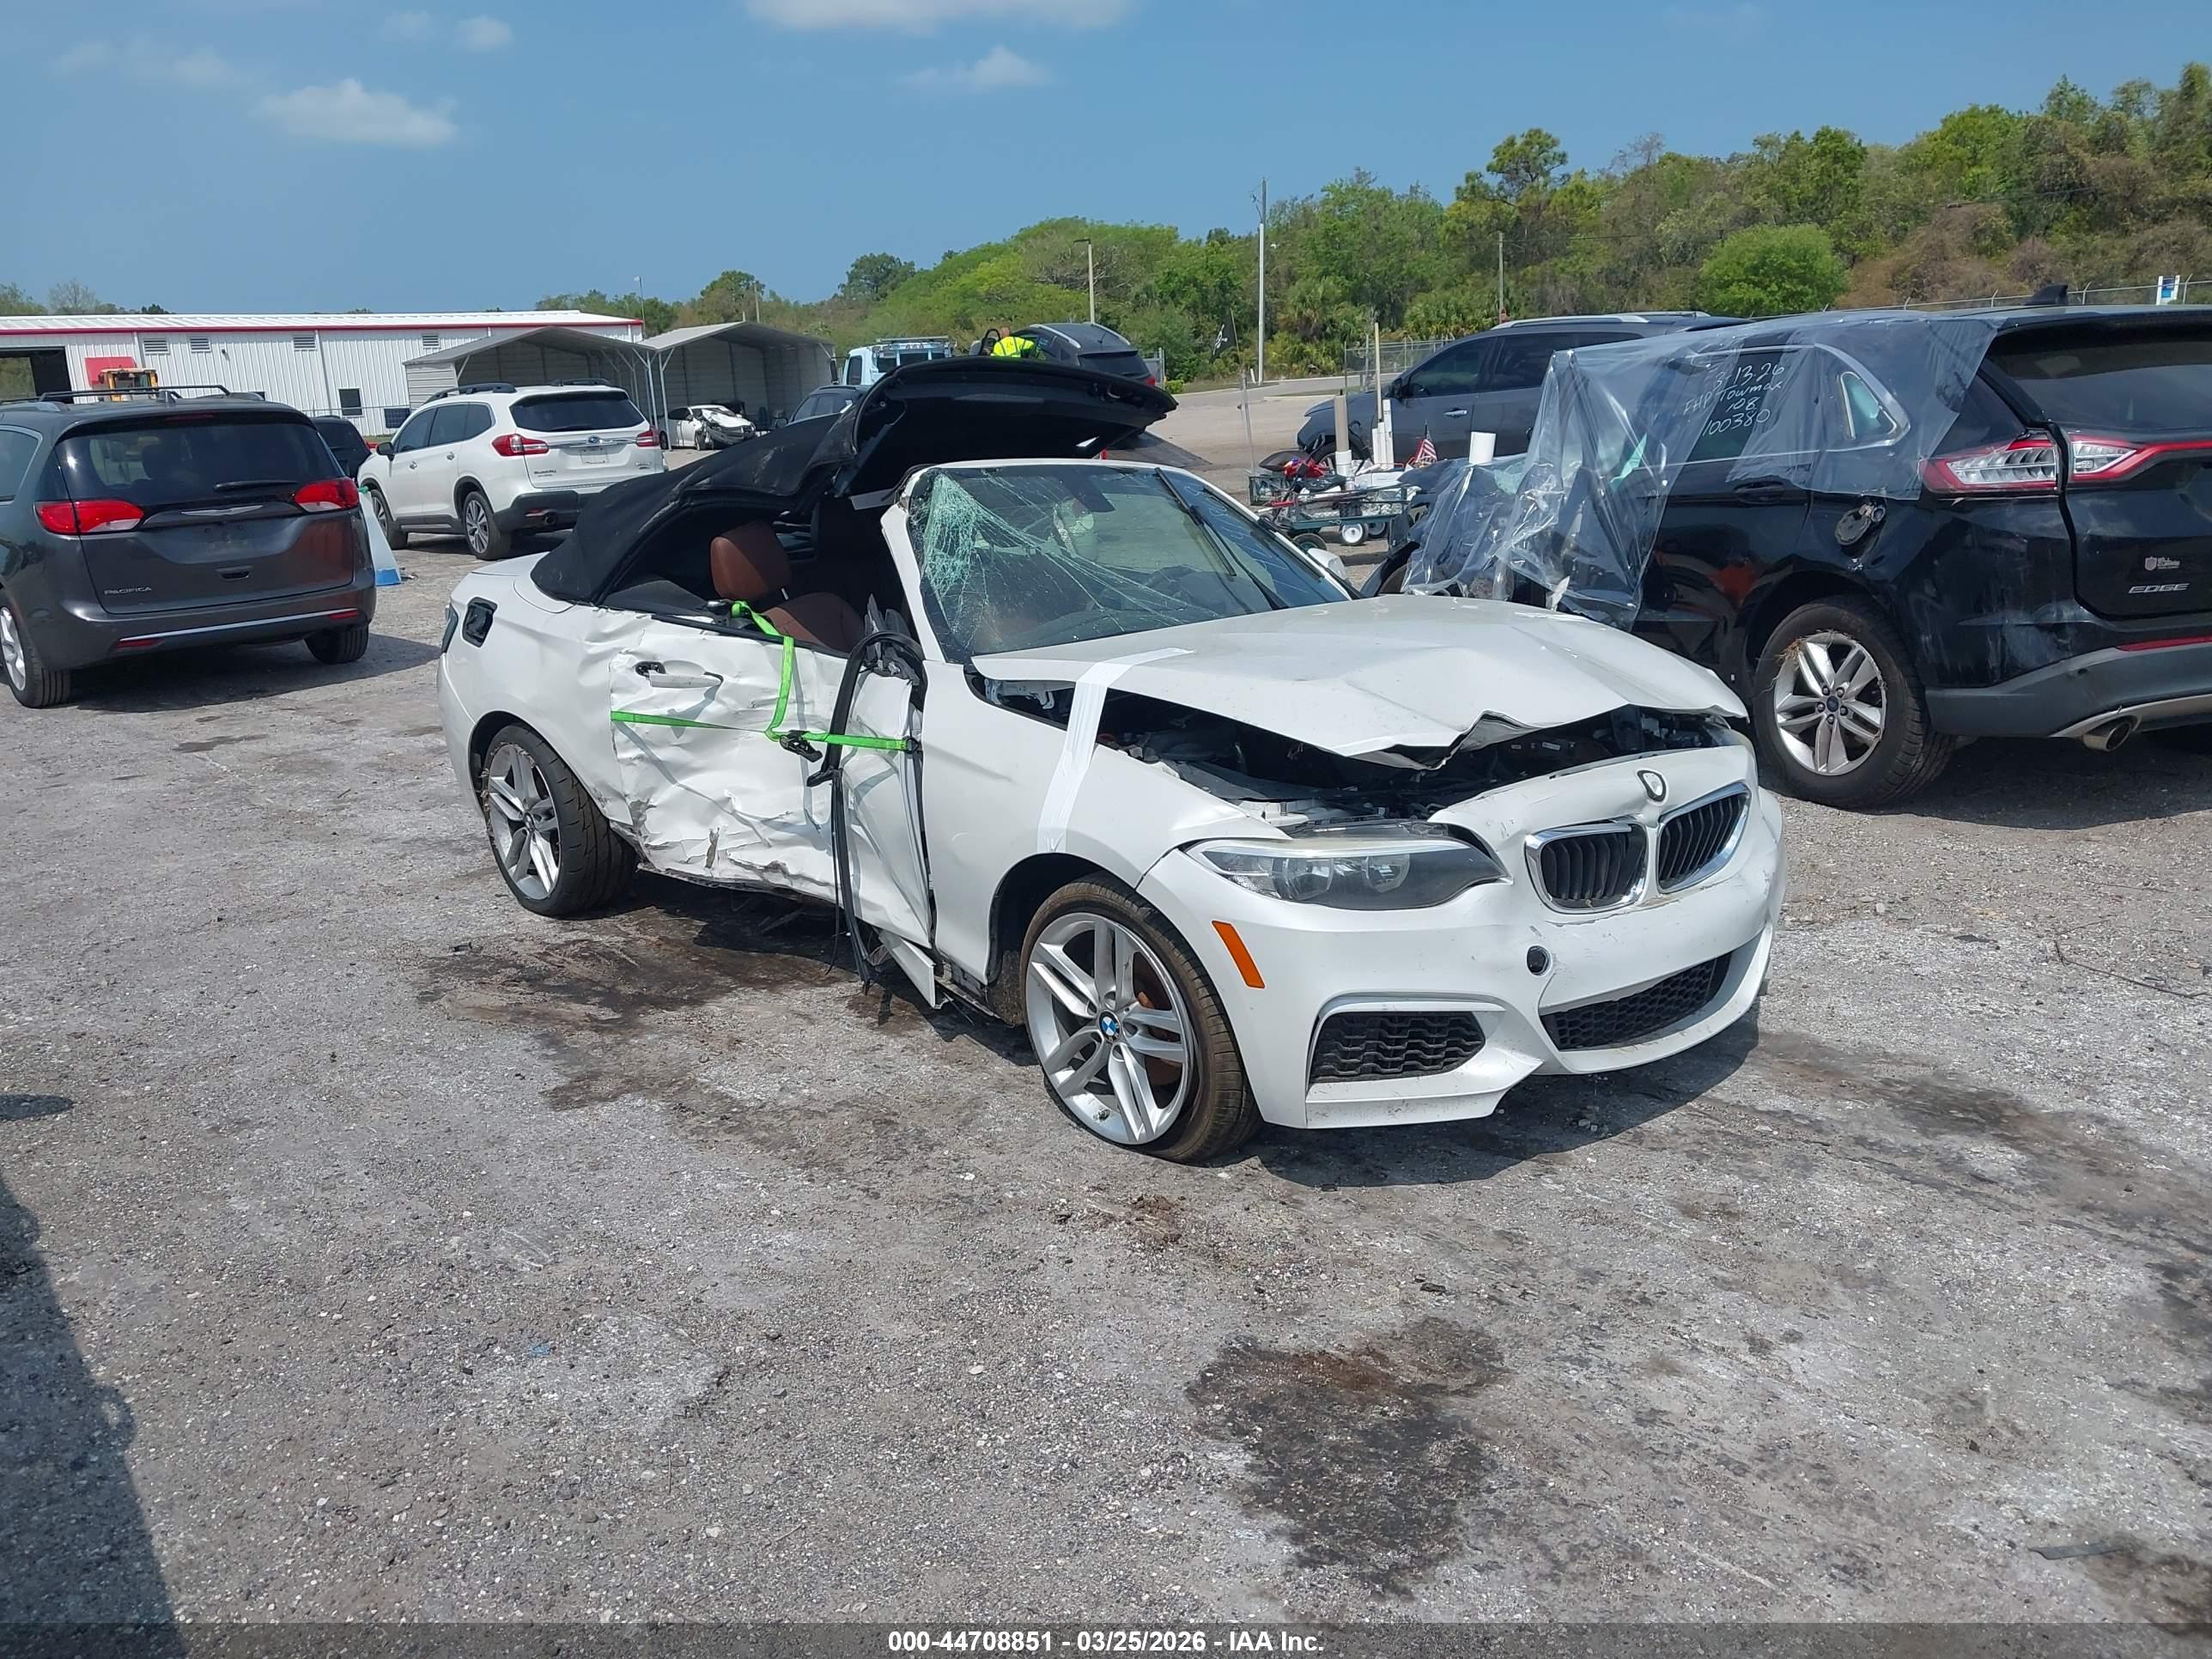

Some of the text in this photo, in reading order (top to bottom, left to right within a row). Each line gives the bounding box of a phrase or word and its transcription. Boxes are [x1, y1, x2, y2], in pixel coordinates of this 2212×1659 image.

[1725, 396, 1760, 412] 108
[1702, 409, 1771, 437] 100380
[104, 586, 152, 595] PACIFICA
[2128, 583, 2190, 594] EDGE
